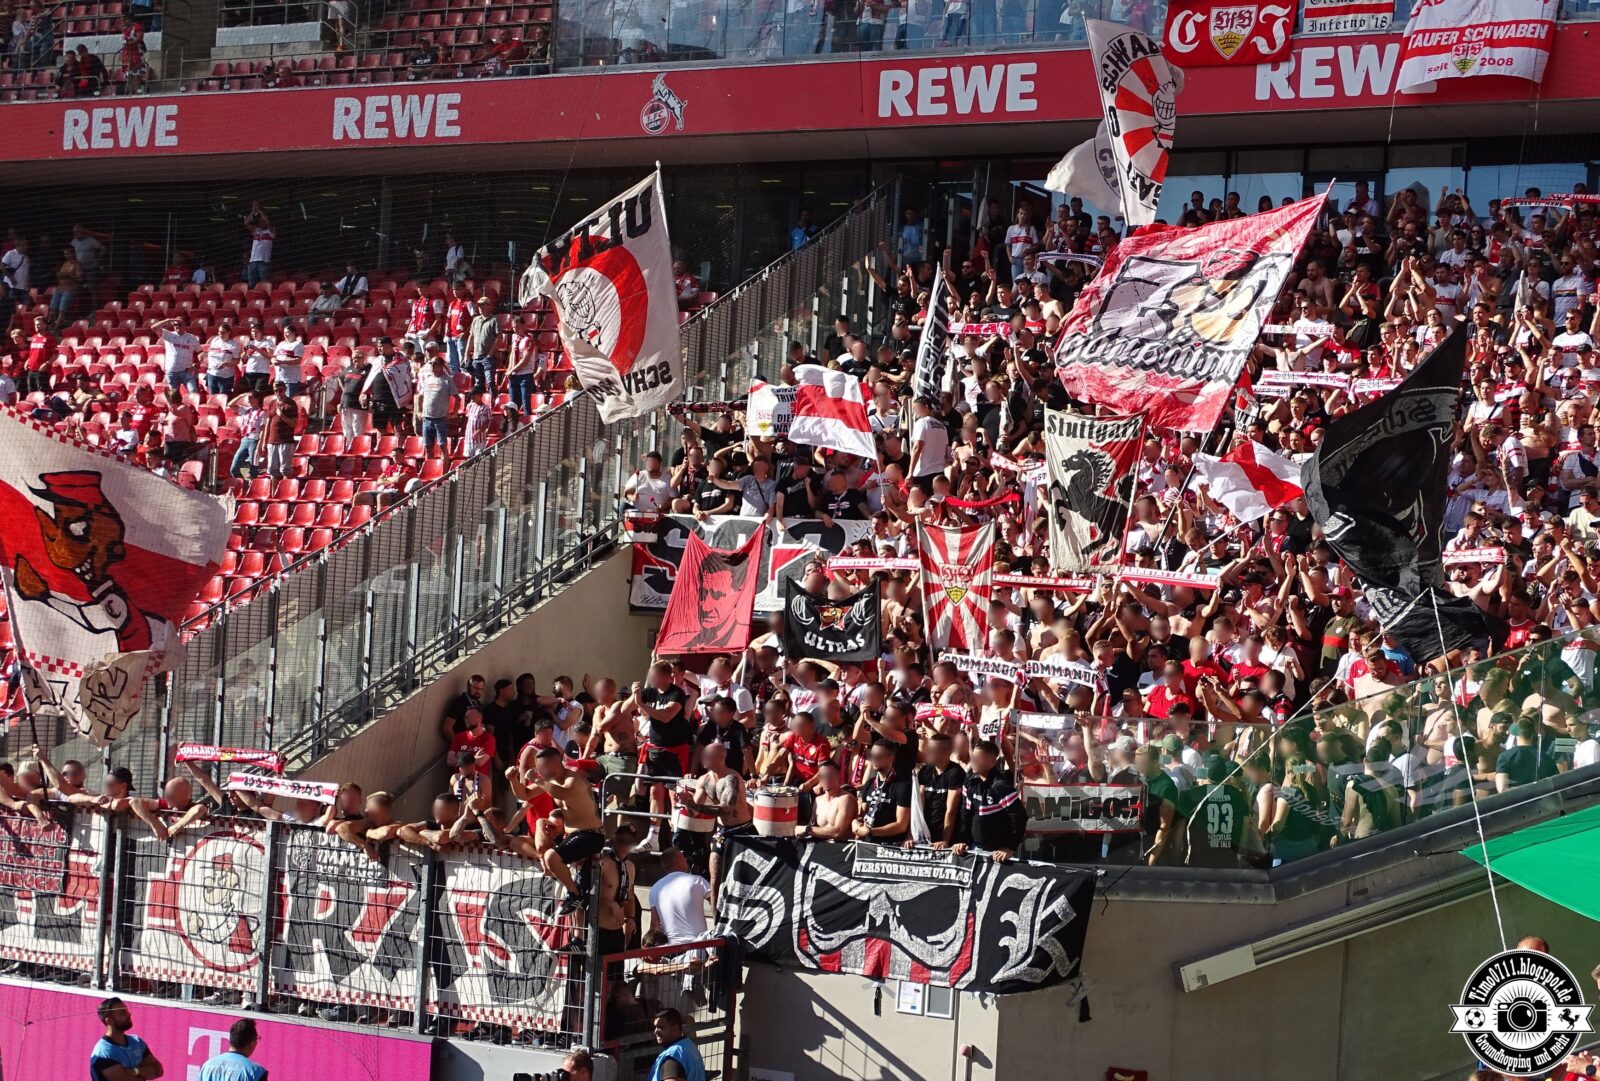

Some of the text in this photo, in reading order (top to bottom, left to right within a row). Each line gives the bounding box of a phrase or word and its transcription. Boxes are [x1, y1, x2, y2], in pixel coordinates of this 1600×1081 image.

[1308, 18, 1366, 32] Inferno
[1463, 23, 1549, 42] SCHWABEN
[1254, 42, 1438, 101] REW
[1427, 57, 1514, 73] seit 2008
[878, 62, 1038, 118] REWE
[62, 104, 179, 151] REWE
[332, 92, 461, 141] REWE
[1046, 414, 1141, 443] Stuttgart
[804, 632, 866, 653] ULTRAS
[1207, 803, 1234, 834] 93
[932, 867, 970, 882] ULTRAS
